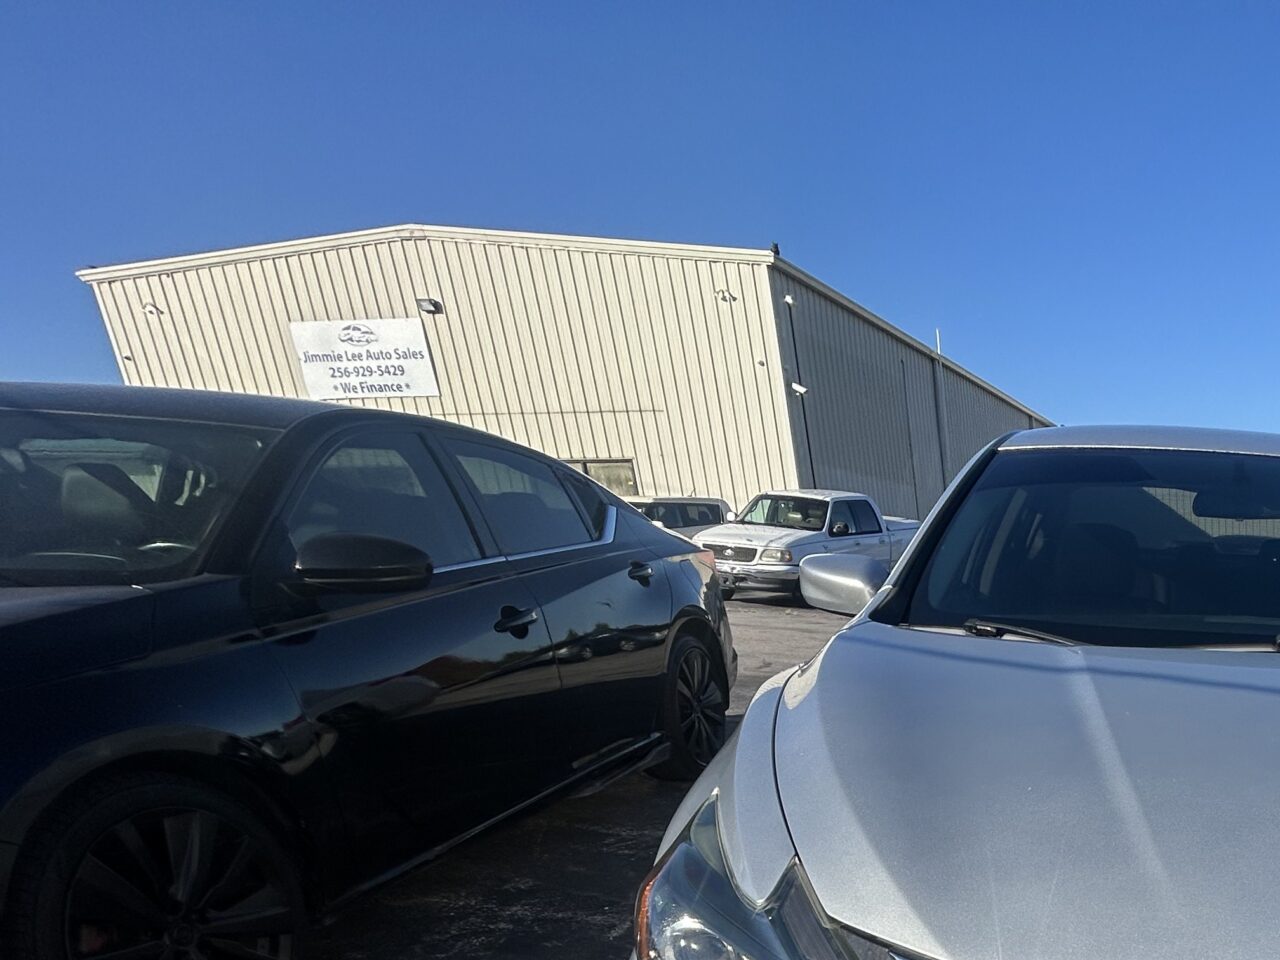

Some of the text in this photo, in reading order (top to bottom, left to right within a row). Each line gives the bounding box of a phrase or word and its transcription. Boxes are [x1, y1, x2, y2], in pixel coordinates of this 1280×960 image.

[303, 347, 424, 363] Jimmie Lee Auto Sales
[329, 365, 405, 378] 256-929-5429
[340, 381, 403, 394] We Finance
